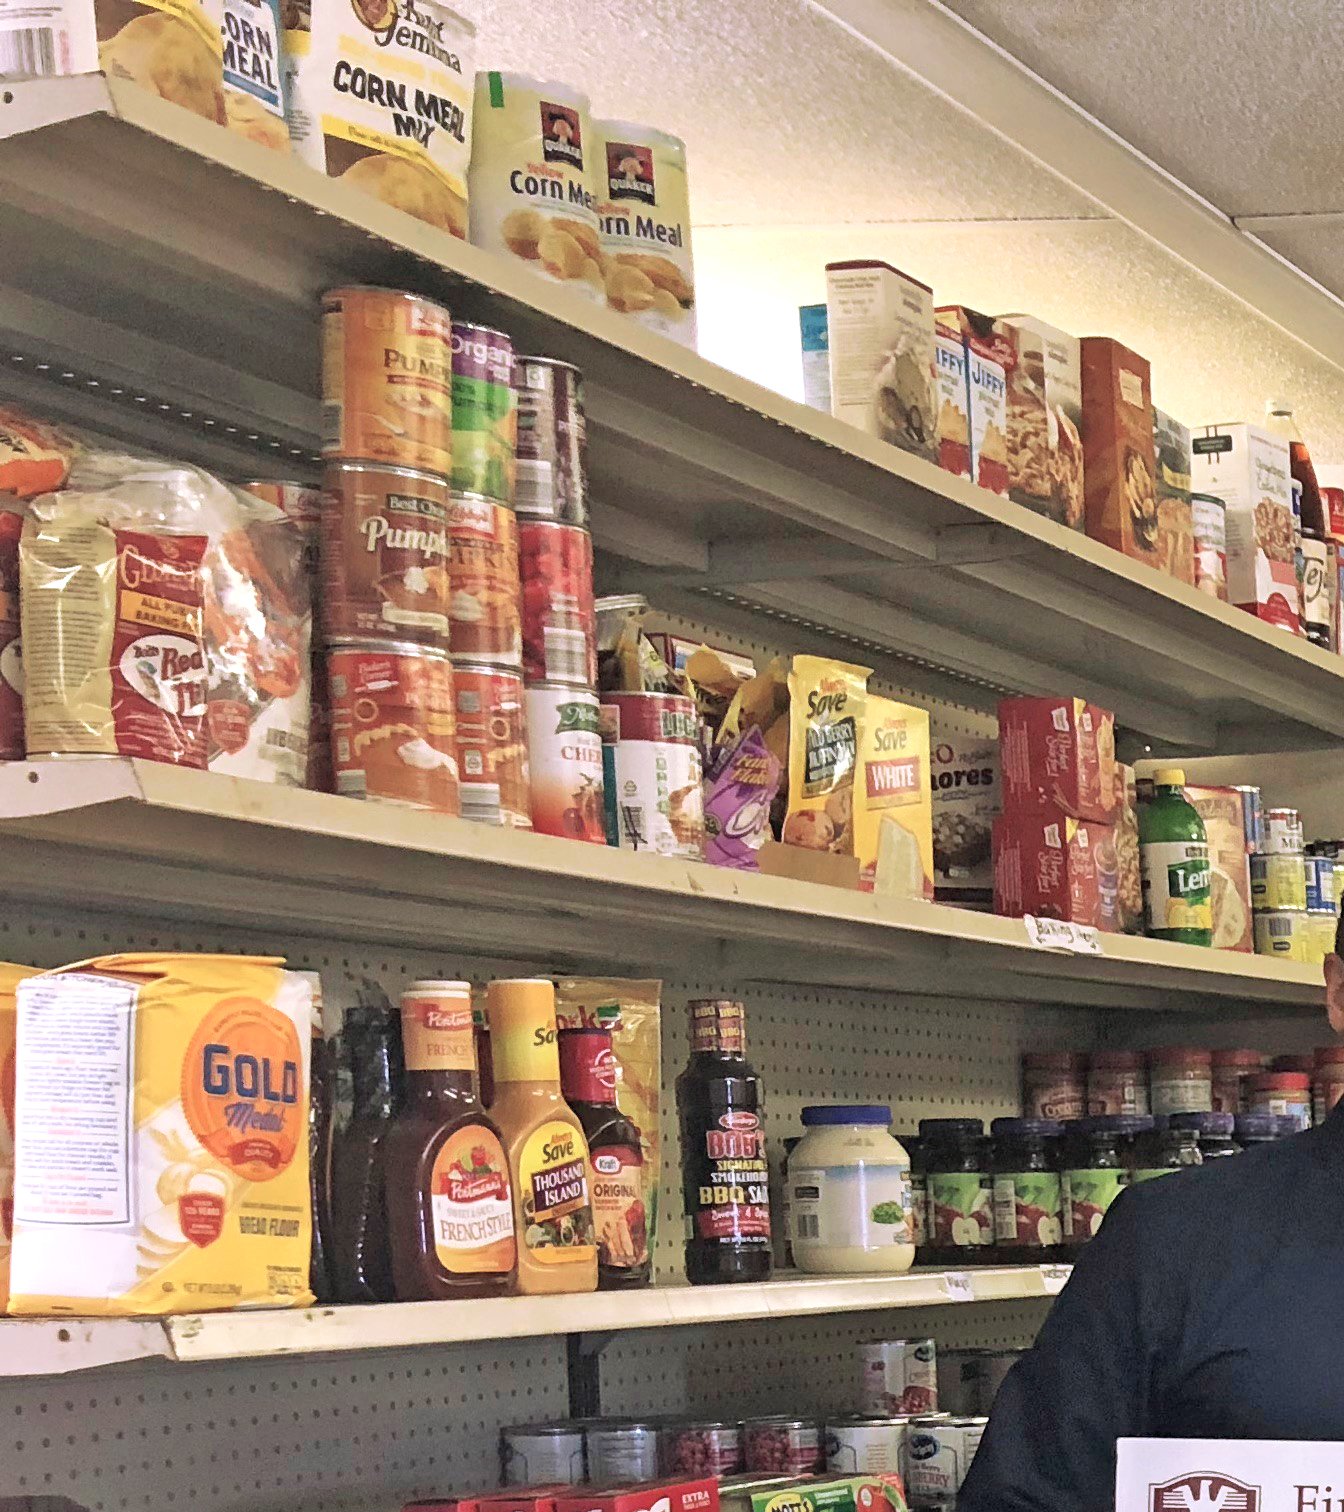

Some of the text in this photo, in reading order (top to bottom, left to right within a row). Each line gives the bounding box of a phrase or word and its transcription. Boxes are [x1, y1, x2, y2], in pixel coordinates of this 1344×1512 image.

[221, 11, 274, 60] ORN
[333, 60, 408, 112] CORN
[413, 88, 466, 144] MEAL
[391, 112, 436, 149] MIX
[510, 169, 564, 200] Corn
[635, 216, 683, 248] Meal
[936, 347, 964, 376] IFFY
[971, 361, 1005, 399] JIFFY
[160, 648, 204, 681] Red
[806, 690, 848, 719] Save
[873, 727, 908, 752] Save
[871, 764, 915, 791] WHITE
[203, 1043, 298, 1104] GOLD
[543, 1141, 575, 1165] Save
[533, 1162, 584, 1191] THOUSAND
[545, 1181, 581, 1206] ISLAND
[699, 1186, 745, 1205] BBQ
[440, 1211, 513, 1241] FRENCH STYLE
[682, 1491, 711, 1504] EXTRA
